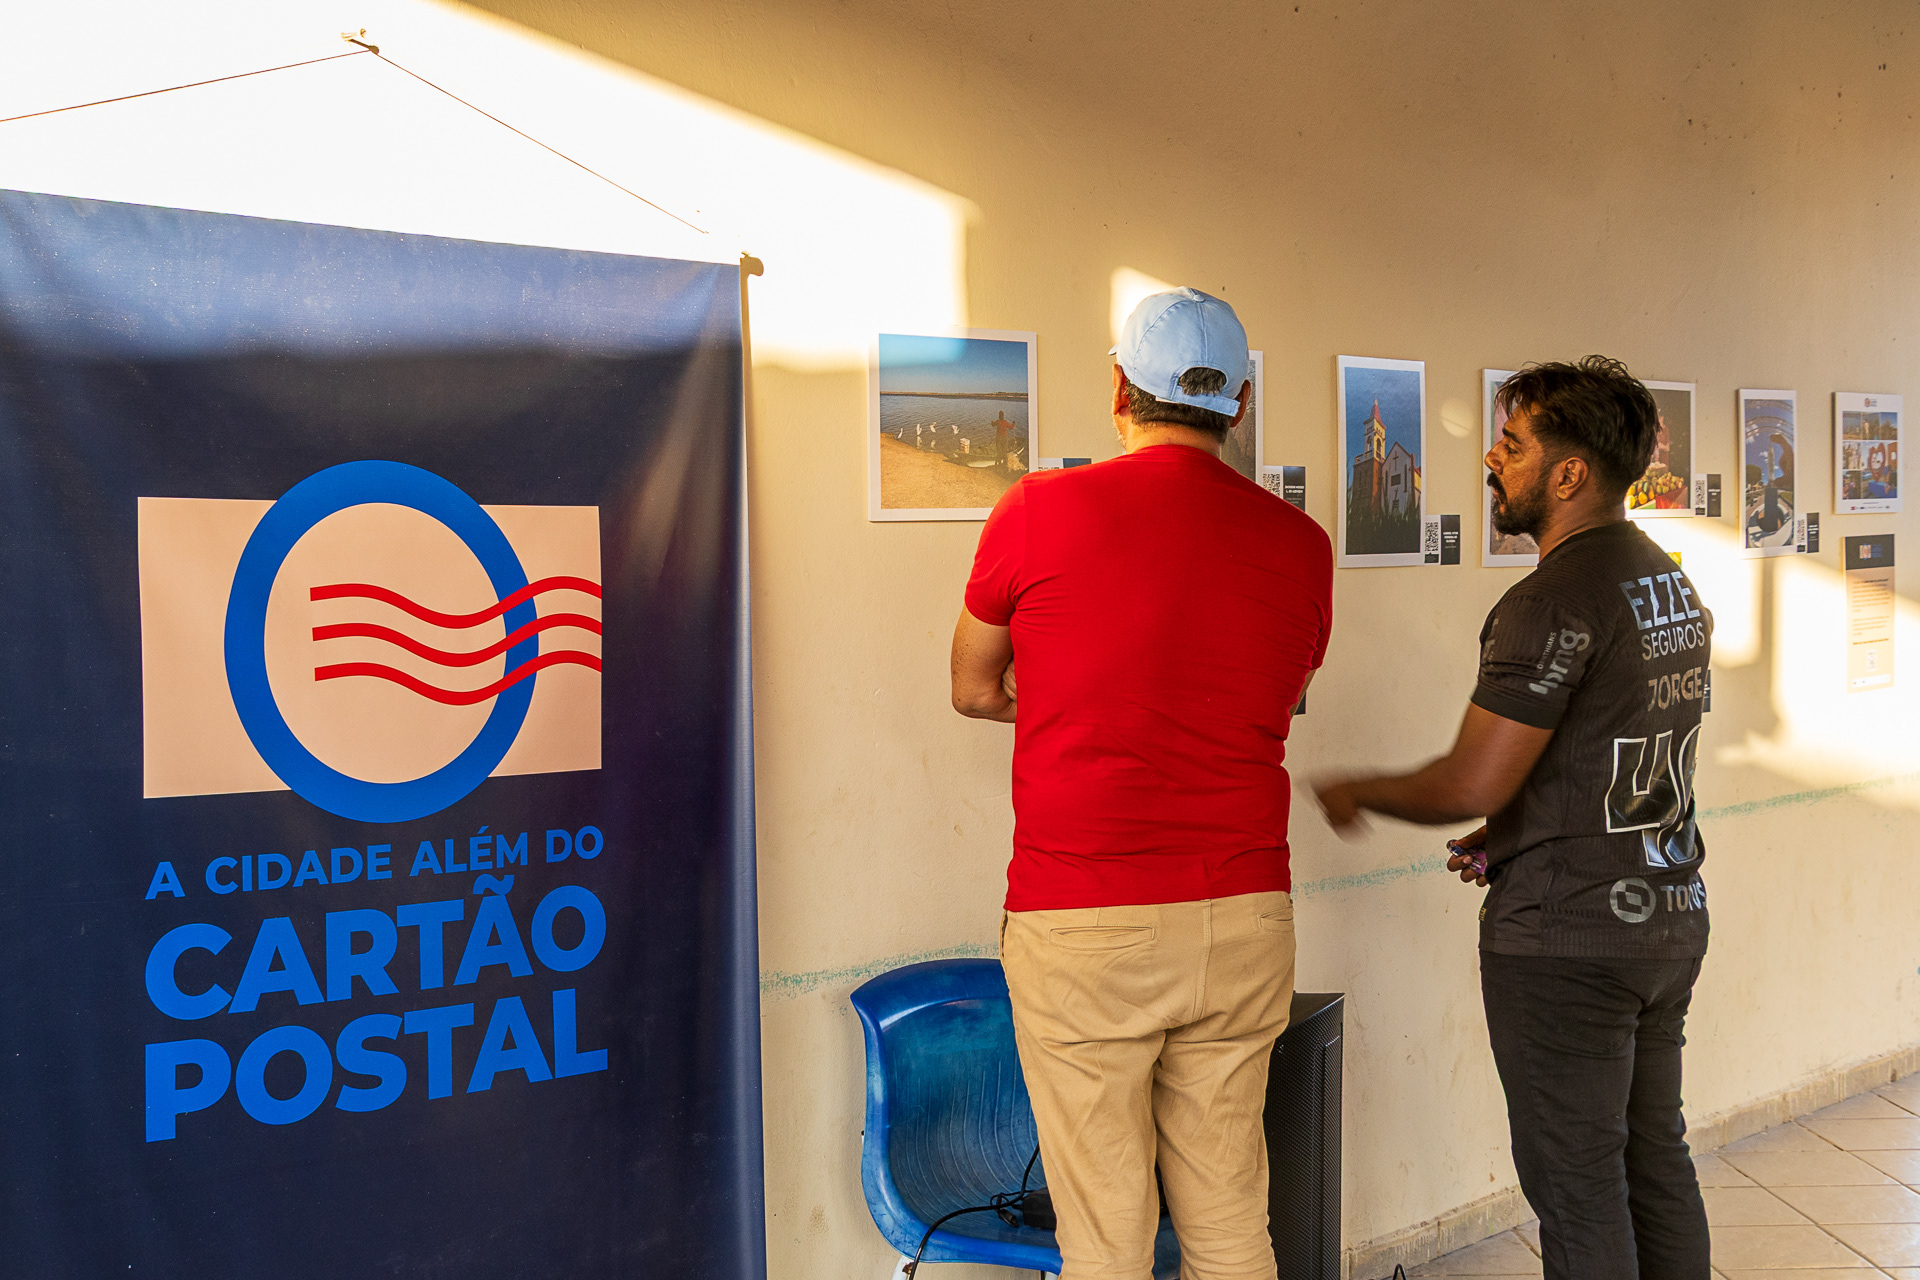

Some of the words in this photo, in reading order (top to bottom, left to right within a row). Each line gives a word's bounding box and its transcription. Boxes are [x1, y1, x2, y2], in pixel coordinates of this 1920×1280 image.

[1618, 570, 1701, 631] EZZE
[1528, 627, 1591, 695] bmg
[1536, 631, 1558, 673] ONTHIANS
[1640, 621, 1706, 661] SEGUROS
[1647, 666, 1703, 712] JORGE
[144, 861, 186, 900] A
[204, 843, 393, 896] CIDADE
[408, 825, 529, 877] ALÉM
[545, 825, 605, 864] DO
[144, 873, 608, 1021] CARTÃO
[144, 987, 609, 1143] POSTAL
